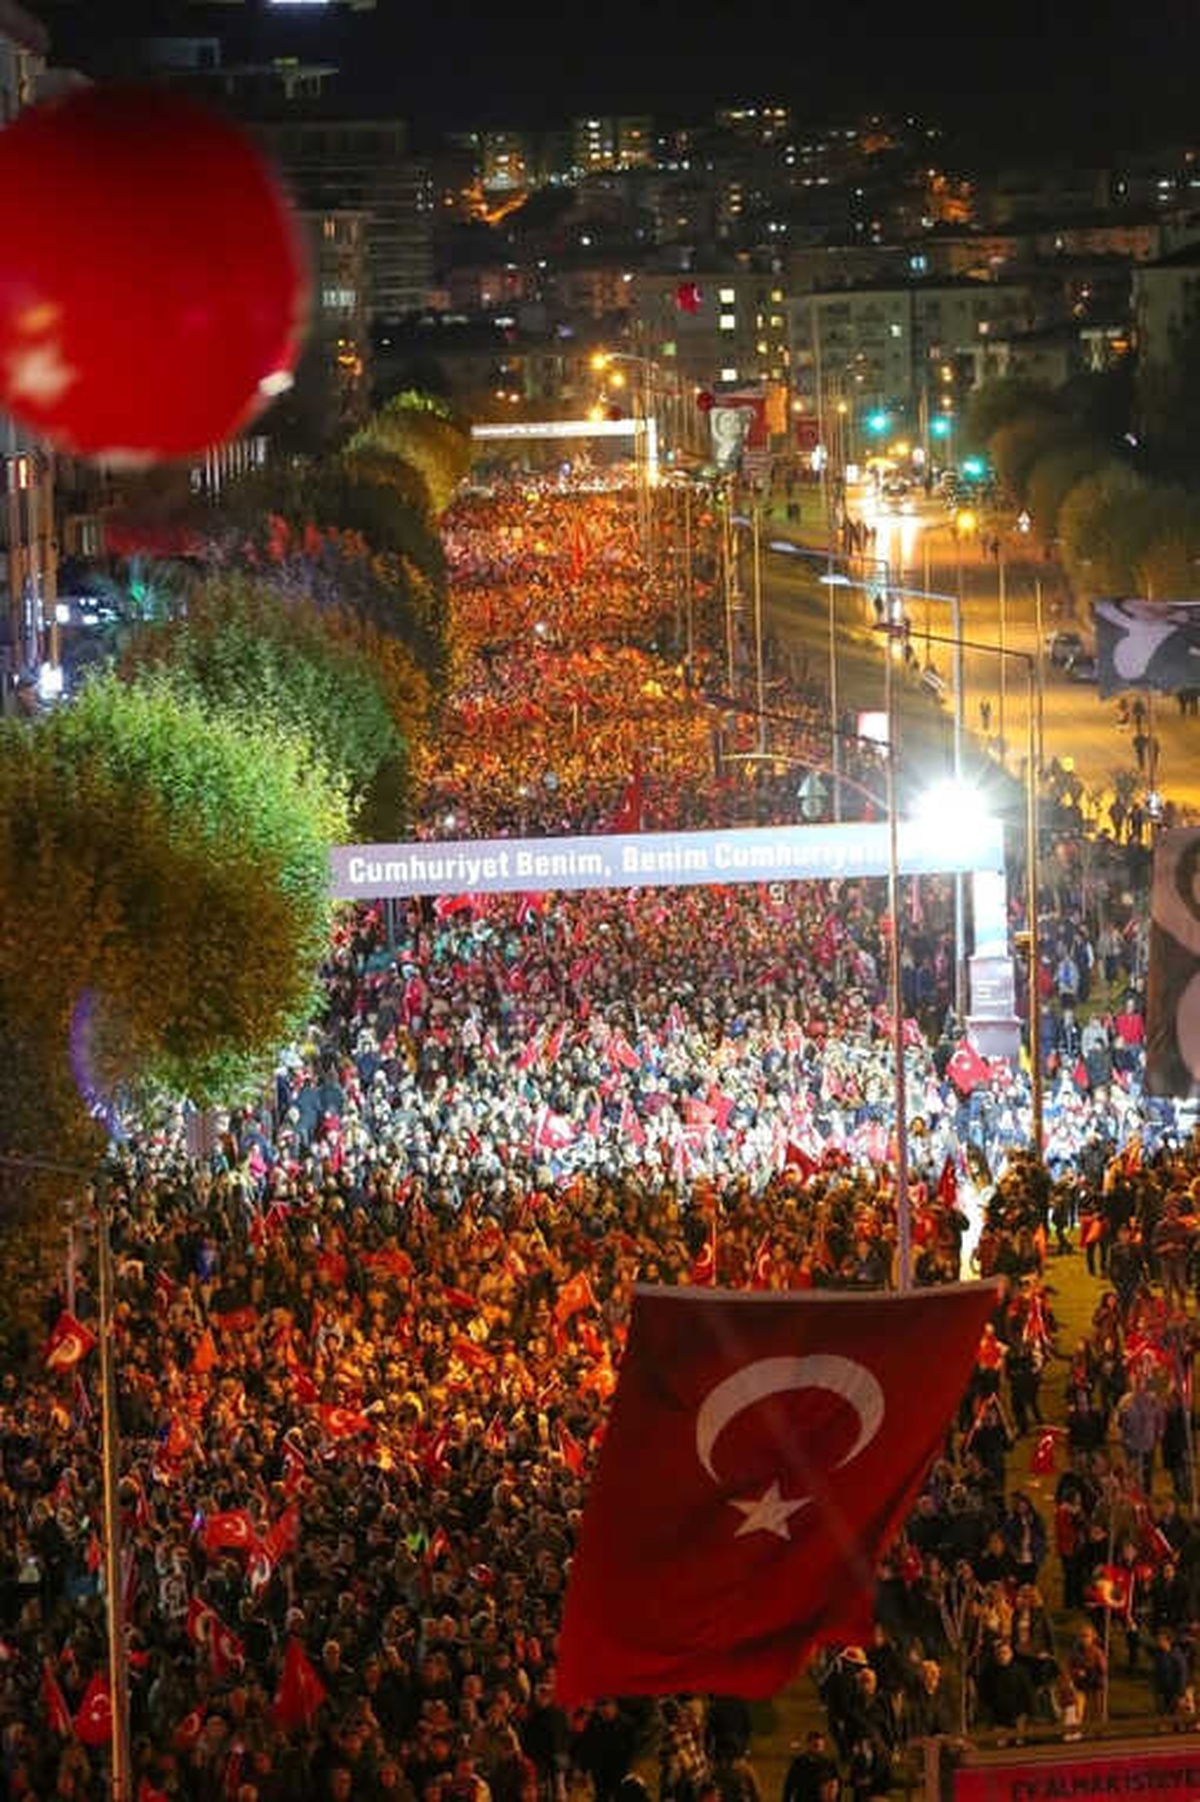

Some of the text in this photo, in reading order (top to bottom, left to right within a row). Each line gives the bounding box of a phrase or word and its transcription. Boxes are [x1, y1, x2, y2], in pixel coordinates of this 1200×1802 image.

[349, 856, 509, 885] Cumhuriyet
[516, 850, 611, 877] Benim,
[622, 845, 707, 872] Benim
